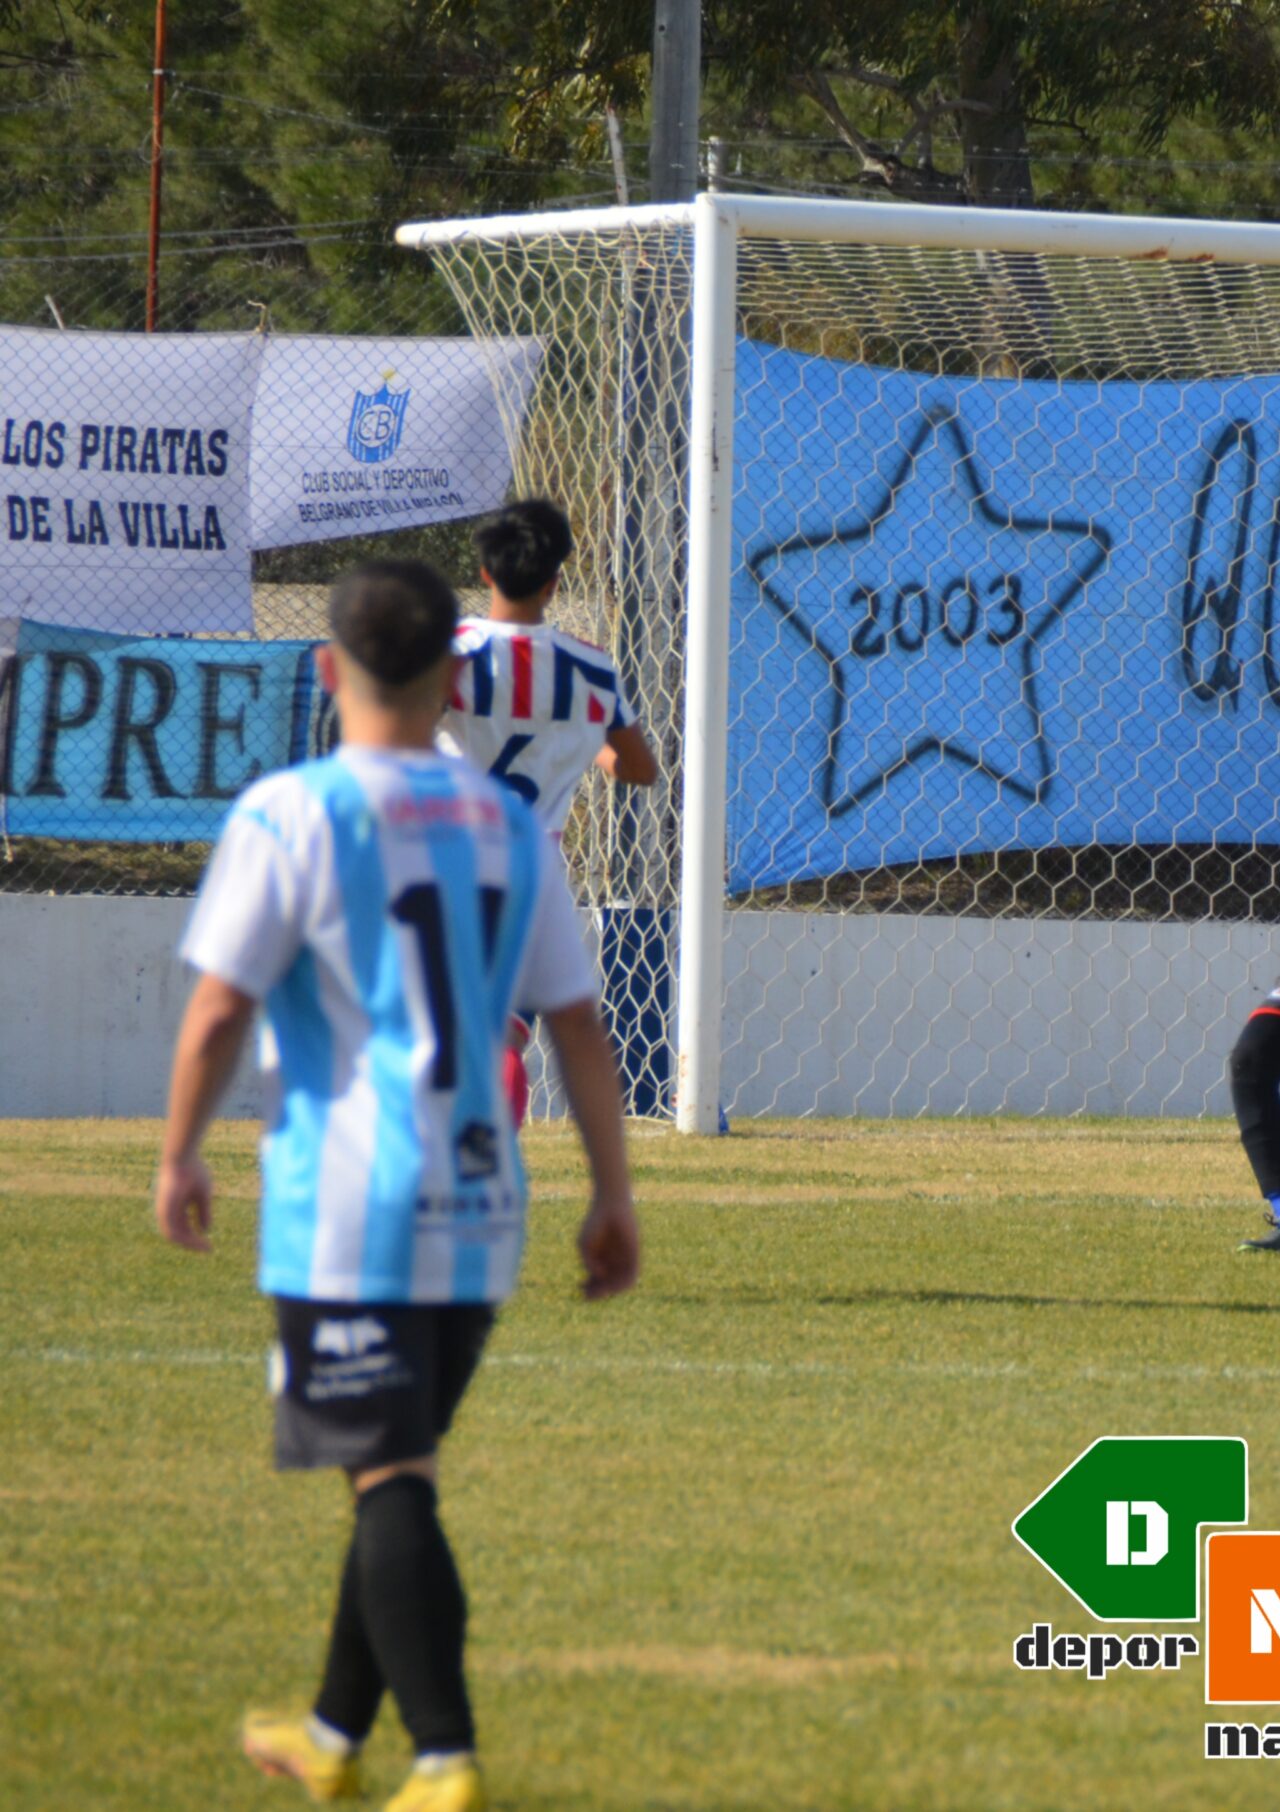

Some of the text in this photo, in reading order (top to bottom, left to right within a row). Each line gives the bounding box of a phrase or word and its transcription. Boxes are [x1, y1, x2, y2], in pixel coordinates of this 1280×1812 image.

[1, 418, 229, 477] LOS PIRATAS
[302, 472, 330, 493] CLUB
[332, 470, 373, 493] SOCIAL
[383, 468, 450, 491] DEPORTIVO
[7, 494, 227, 551] DE LA VILLA
[298, 501, 361, 523] BELGRANO
[361, 500, 381, 518] DE
[849, 575, 1024, 657] 2003
